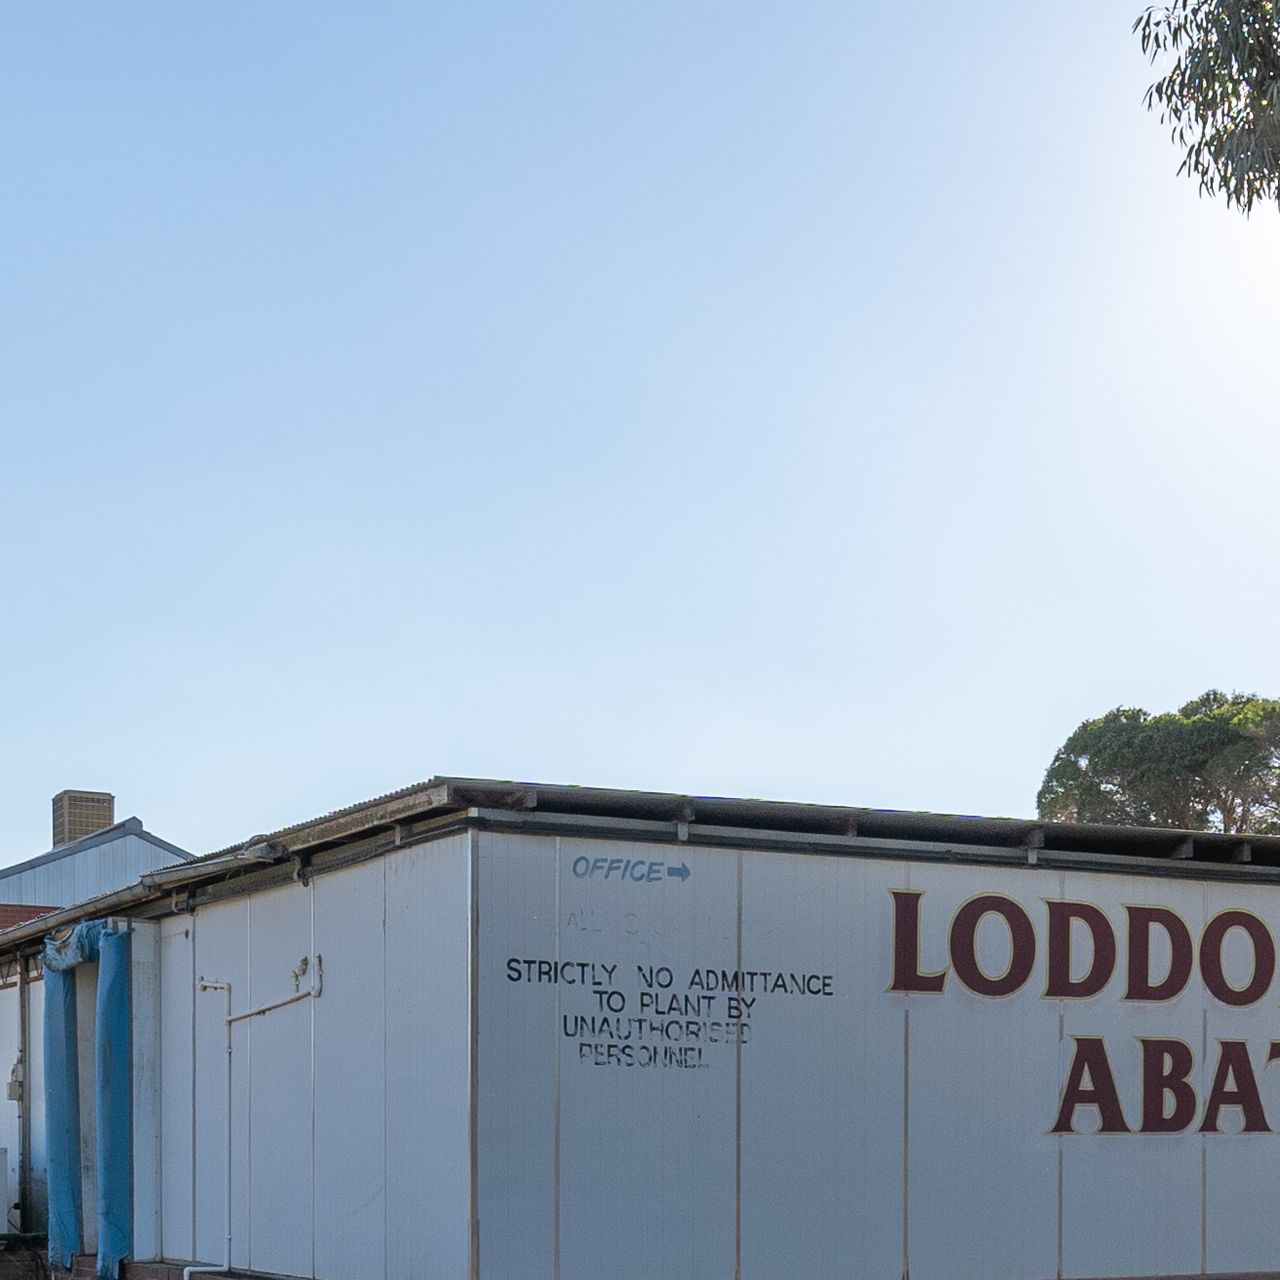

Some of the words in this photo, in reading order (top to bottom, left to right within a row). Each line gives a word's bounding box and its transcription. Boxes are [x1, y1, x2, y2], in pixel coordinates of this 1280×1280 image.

[572, 855, 665, 883] OFFICE
[506, 957, 618, 987] STRICTLY
[636, 964, 674, 989] NO
[687, 968, 835, 997] ADMITTANCE
[592, 989, 626, 1014] TO
[639, 991, 718, 1018] PLANT
[727, 996, 757, 1020] BY
[562, 1013, 753, 1046] UNAUTHORISED
[578, 1041, 711, 1069] PERSONNEL
